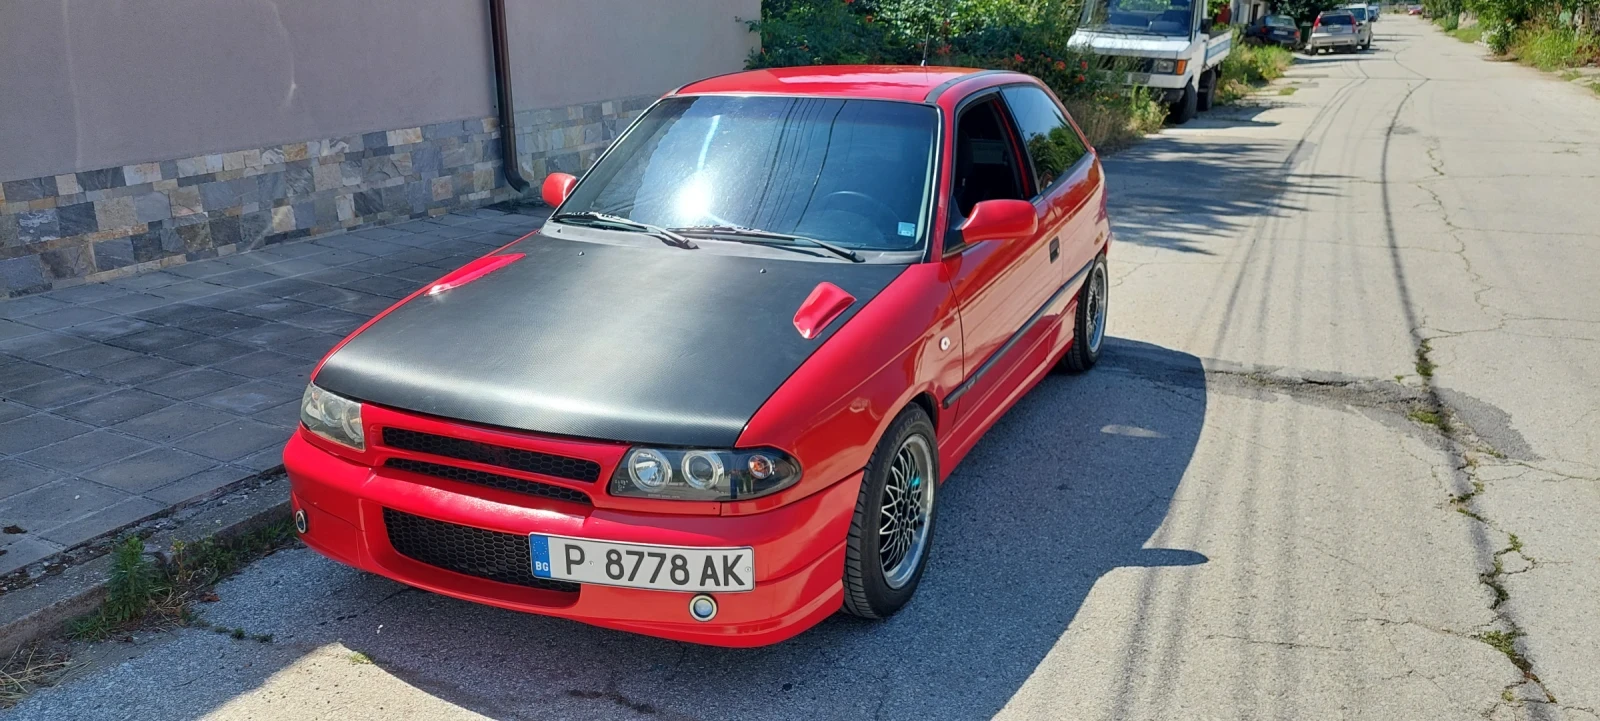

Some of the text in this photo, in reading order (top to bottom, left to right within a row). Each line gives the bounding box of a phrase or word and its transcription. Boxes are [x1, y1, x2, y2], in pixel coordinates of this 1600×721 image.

[535, 561, 549, 571] BG
[564, 544, 745, 587] P 8778 AK
